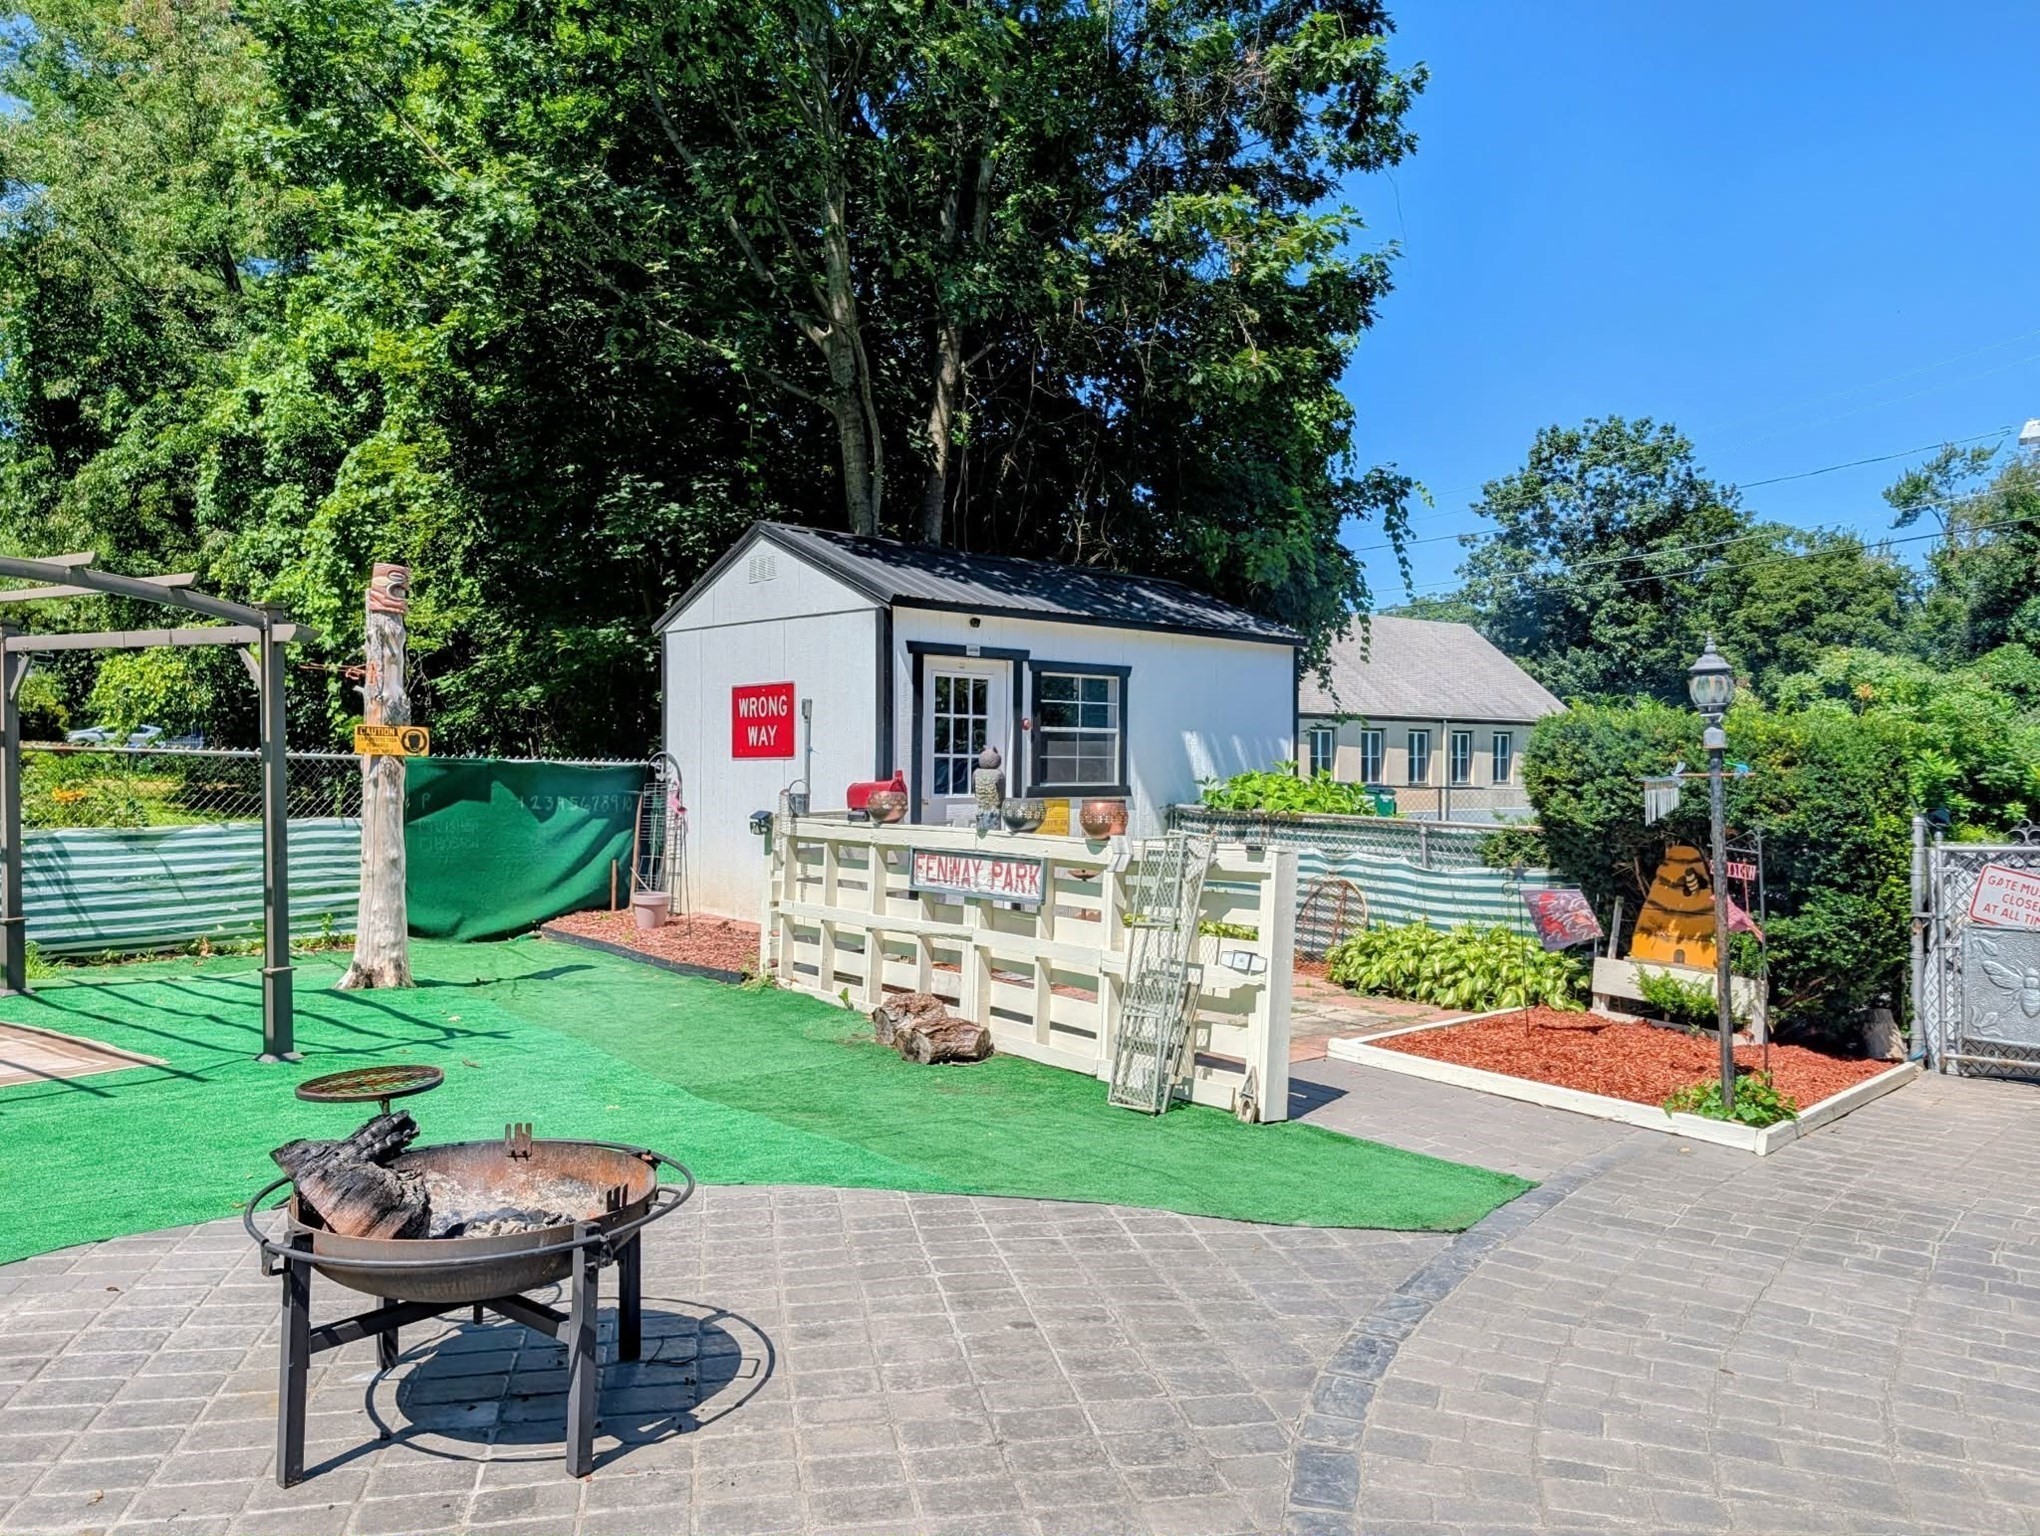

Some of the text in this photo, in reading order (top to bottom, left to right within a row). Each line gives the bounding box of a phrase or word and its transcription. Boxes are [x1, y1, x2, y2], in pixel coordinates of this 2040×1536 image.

[738, 695, 788, 718] WRONG
[360, 727, 396, 736] CAUTION
[747, 724, 777, 747] WAY
[530, 795, 542, 810] 2
[544, 796, 554, 811] 3
[600, 794, 610, 812] 8
[610, 794, 619, 813] 9
[915, 853, 1040, 894] FENWAY PARK
[1988, 875, 2040, 898] GATE MU
[1983, 903, 1999, 915] AT
[2000, 908, 2020, 921] ALL
[2002, 893, 2040, 912] CLOSE
